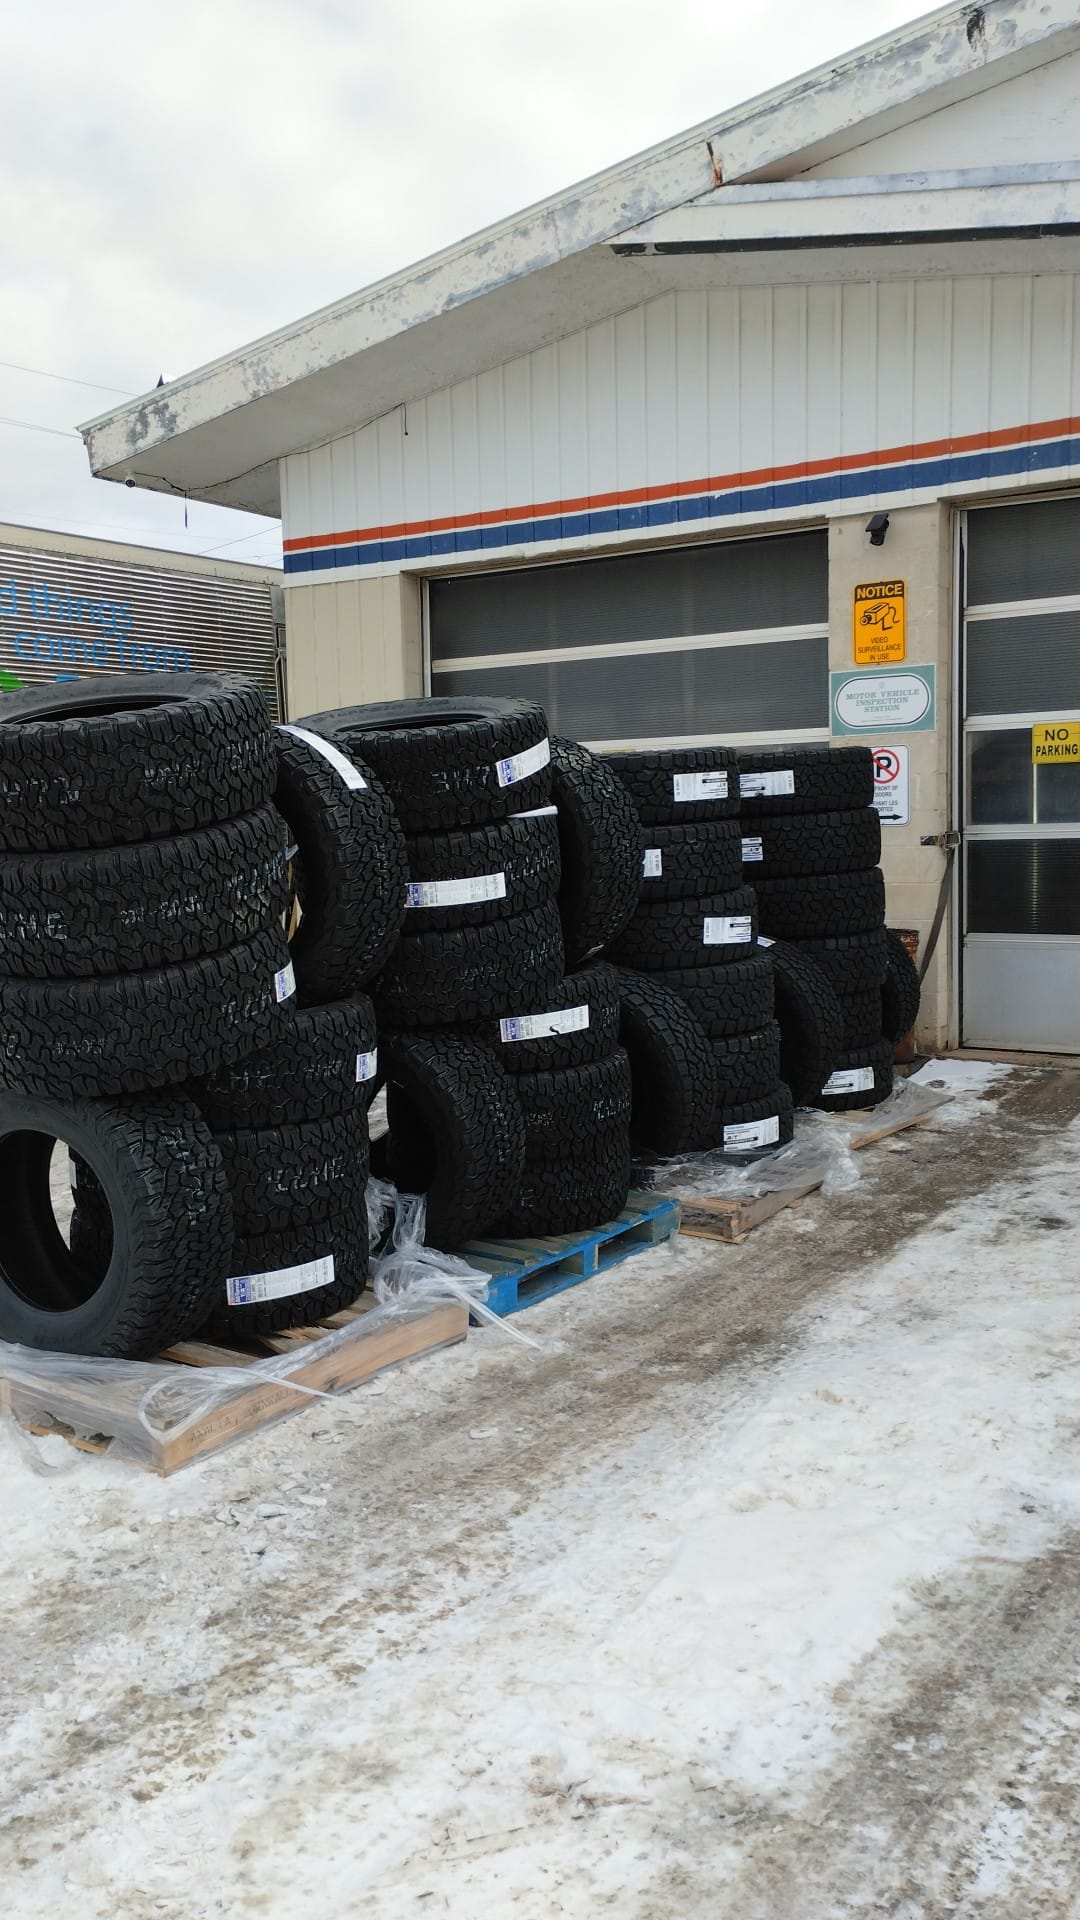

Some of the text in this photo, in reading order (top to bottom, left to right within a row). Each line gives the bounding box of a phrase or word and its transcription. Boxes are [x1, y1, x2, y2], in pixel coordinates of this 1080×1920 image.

[857, 584, 903, 599] NOTICE
[28, 582, 133, 636] things
[14, 632, 191, 673] come from
[858, 643, 902, 653] SURVEILLANCE
[846, 688, 920, 700] MOTOR VEHICLE
[856, 696, 909, 706] INSPECTION
[864, 704, 900, 713] STATION
[1045, 728, 1069, 742] NO
[1036, 744, 1078, 757] PARKING
